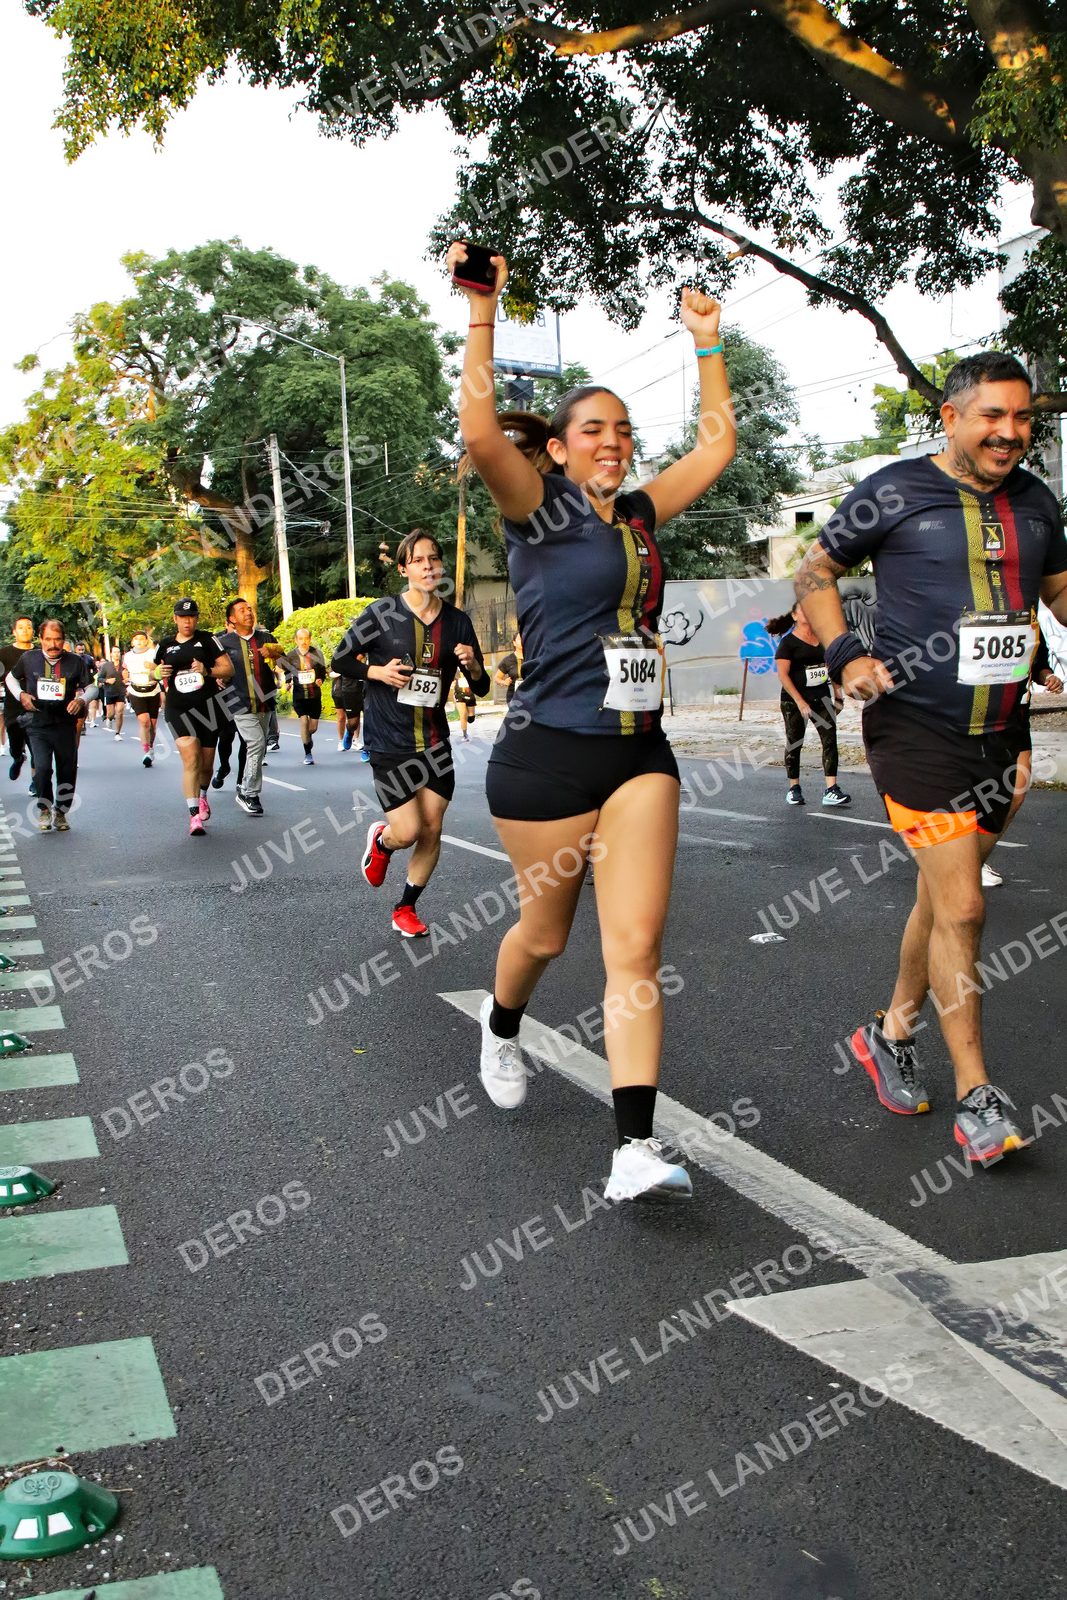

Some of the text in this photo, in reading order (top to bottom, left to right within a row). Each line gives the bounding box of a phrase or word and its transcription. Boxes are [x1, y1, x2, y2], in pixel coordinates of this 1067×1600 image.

[972, 635, 1026, 660] 5085
[620, 658, 656, 683] 5084
[810, 670, 826, 679] 3949
[40, 683, 60, 692] 4768
[179, 676, 198, 686] 5362
[408, 676, 437, 694] 1582
